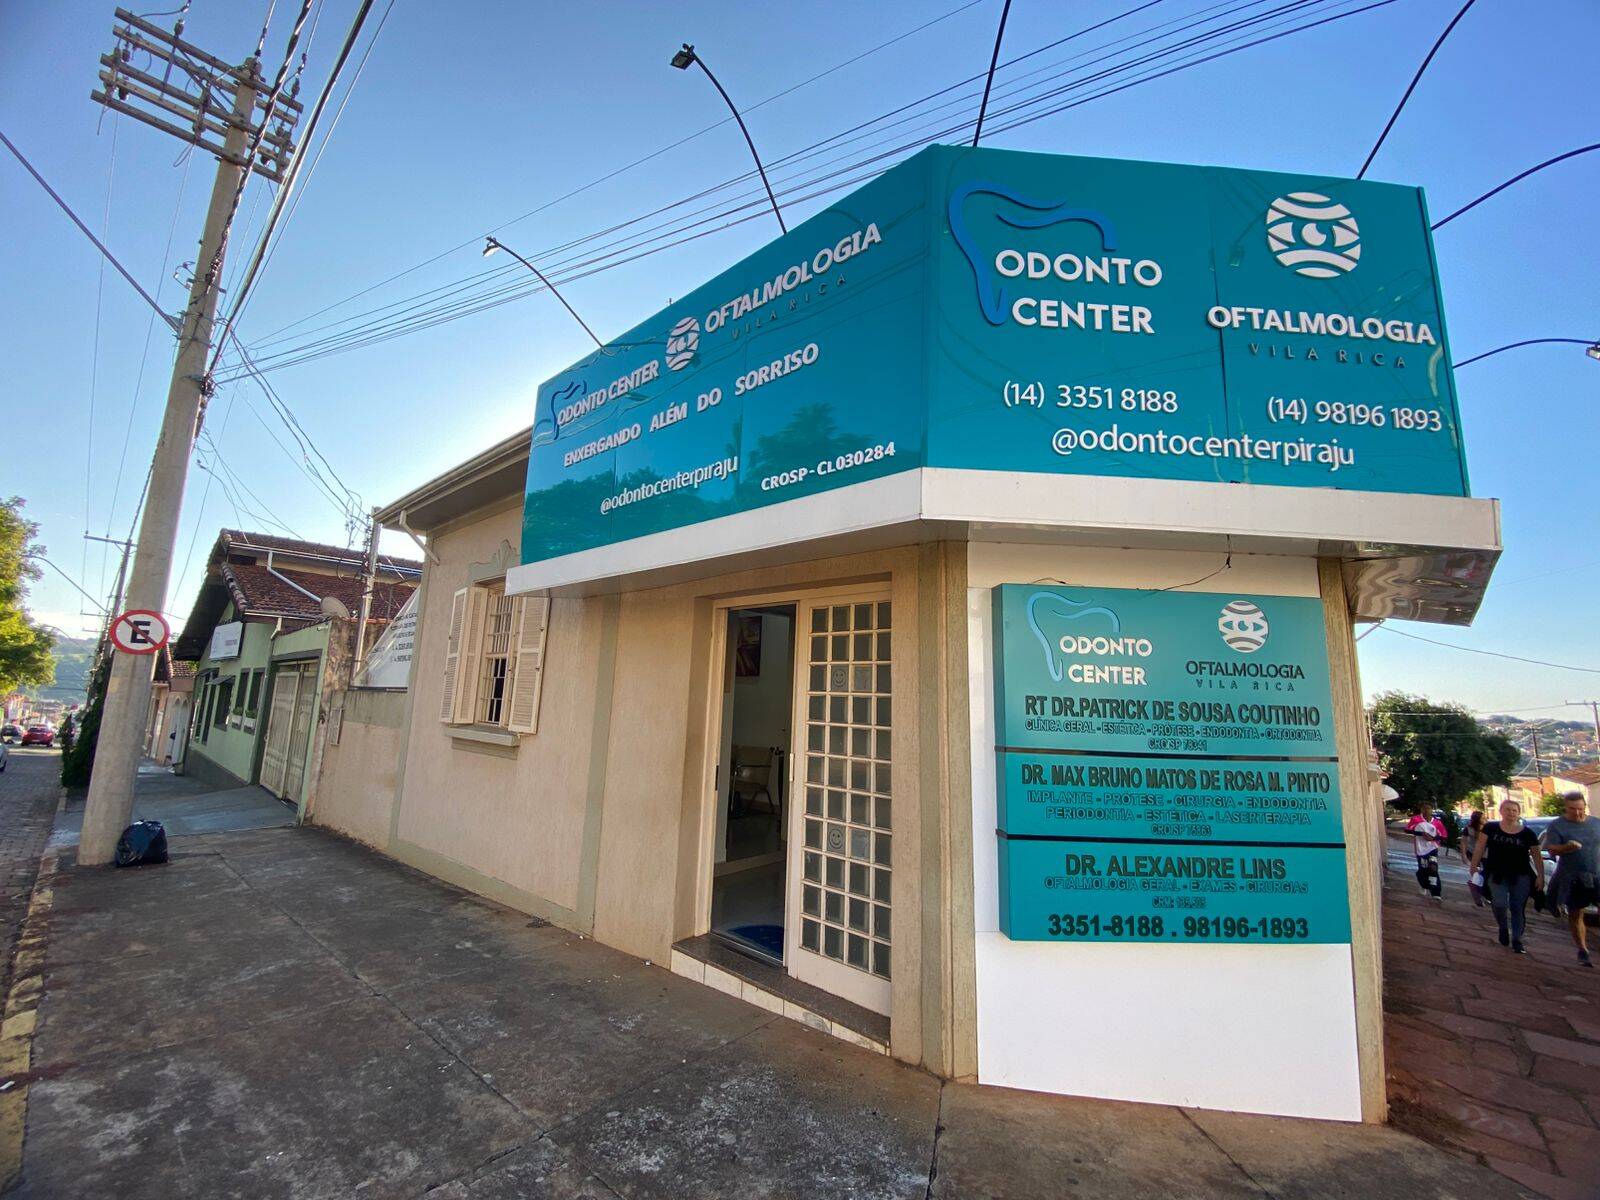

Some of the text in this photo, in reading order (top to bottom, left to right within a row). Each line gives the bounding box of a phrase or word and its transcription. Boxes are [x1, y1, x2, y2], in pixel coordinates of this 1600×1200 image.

[704, 222, 882, 333] OFTALMOLOGIA
[995, 249, 1163, 287] ODONTO
[732, 273, 846, 340] VILA RICA
[1012, 297, 1155, 334] CENTER
[1207, 306, 1436, 346] OFTALMOLOGIA
[1250, 343, 1406, 368] VILA RICA
[557, 360, 660, 426] ODONTO CENTER
[564, 342, 819, 467] ENXERGANDO ALÉM DO SORRISO
[1004, 380, 1178, 413] (14) 3351 8188
[1267, 396, 1442, 432] (14) 98196 1893
[1052, 423, 1354, 472] @odontocenterpiraju
[600, 456, 738, 515] @odontocenterpiraju
[131, 621, 151, 643] E
[1059, 635, 1152, 657] ODONTO
[1068, 664, 1148, 686] CENTER
[1185, 660, 1305, 680] OFTALMOLOGIA
[1195, 678, 1295, 692] VILA RICA
[1025, 695, 1047, 716] RT
[1152, 700, 1175, 721] DE
[1178, 701, 1235, 723] SOUSA
[1238, 703, 1320, 726] COUTINHO
[1025, 716, 1063, 732] CLÍNICA
[1063, 720, 1095, 734] GERAL
[1202, 726, 1260, 739] ENDODONTIA
[1265, 728, 1322, 741] ORTODONTIA
[1022, 763, 1330, 793] DR. MAX BRUNO MATOS DE ROSA M. PINTO
[1027, 790, 1093, 804] IMPLANTE
[1103, 791, 1164, 806] PRÓTESE
[1174, 795, 1235, 808] CIRURGIA
[1245, 797, 1327, 810] ENDODONTIA
[1046, 806, 1135, 821] PERIODONTIA
[1215, 811, 1311, 825] LASERTERAPIA
[1065, 854, 1286, 879] DR. ALEXANDRE LINS
[1044, 877, 1138, 891] OFTALMOLOGIA
[1141, 878, 1180, 892] GERAL
[1190, 879, 1237, 892] EXAMES
[1246, 880, 1308, 894] CIRURGIAS
[1048, 913, 1164, 937] 3351-8188
[1184, 916, 1309, 938] 98196-1893
